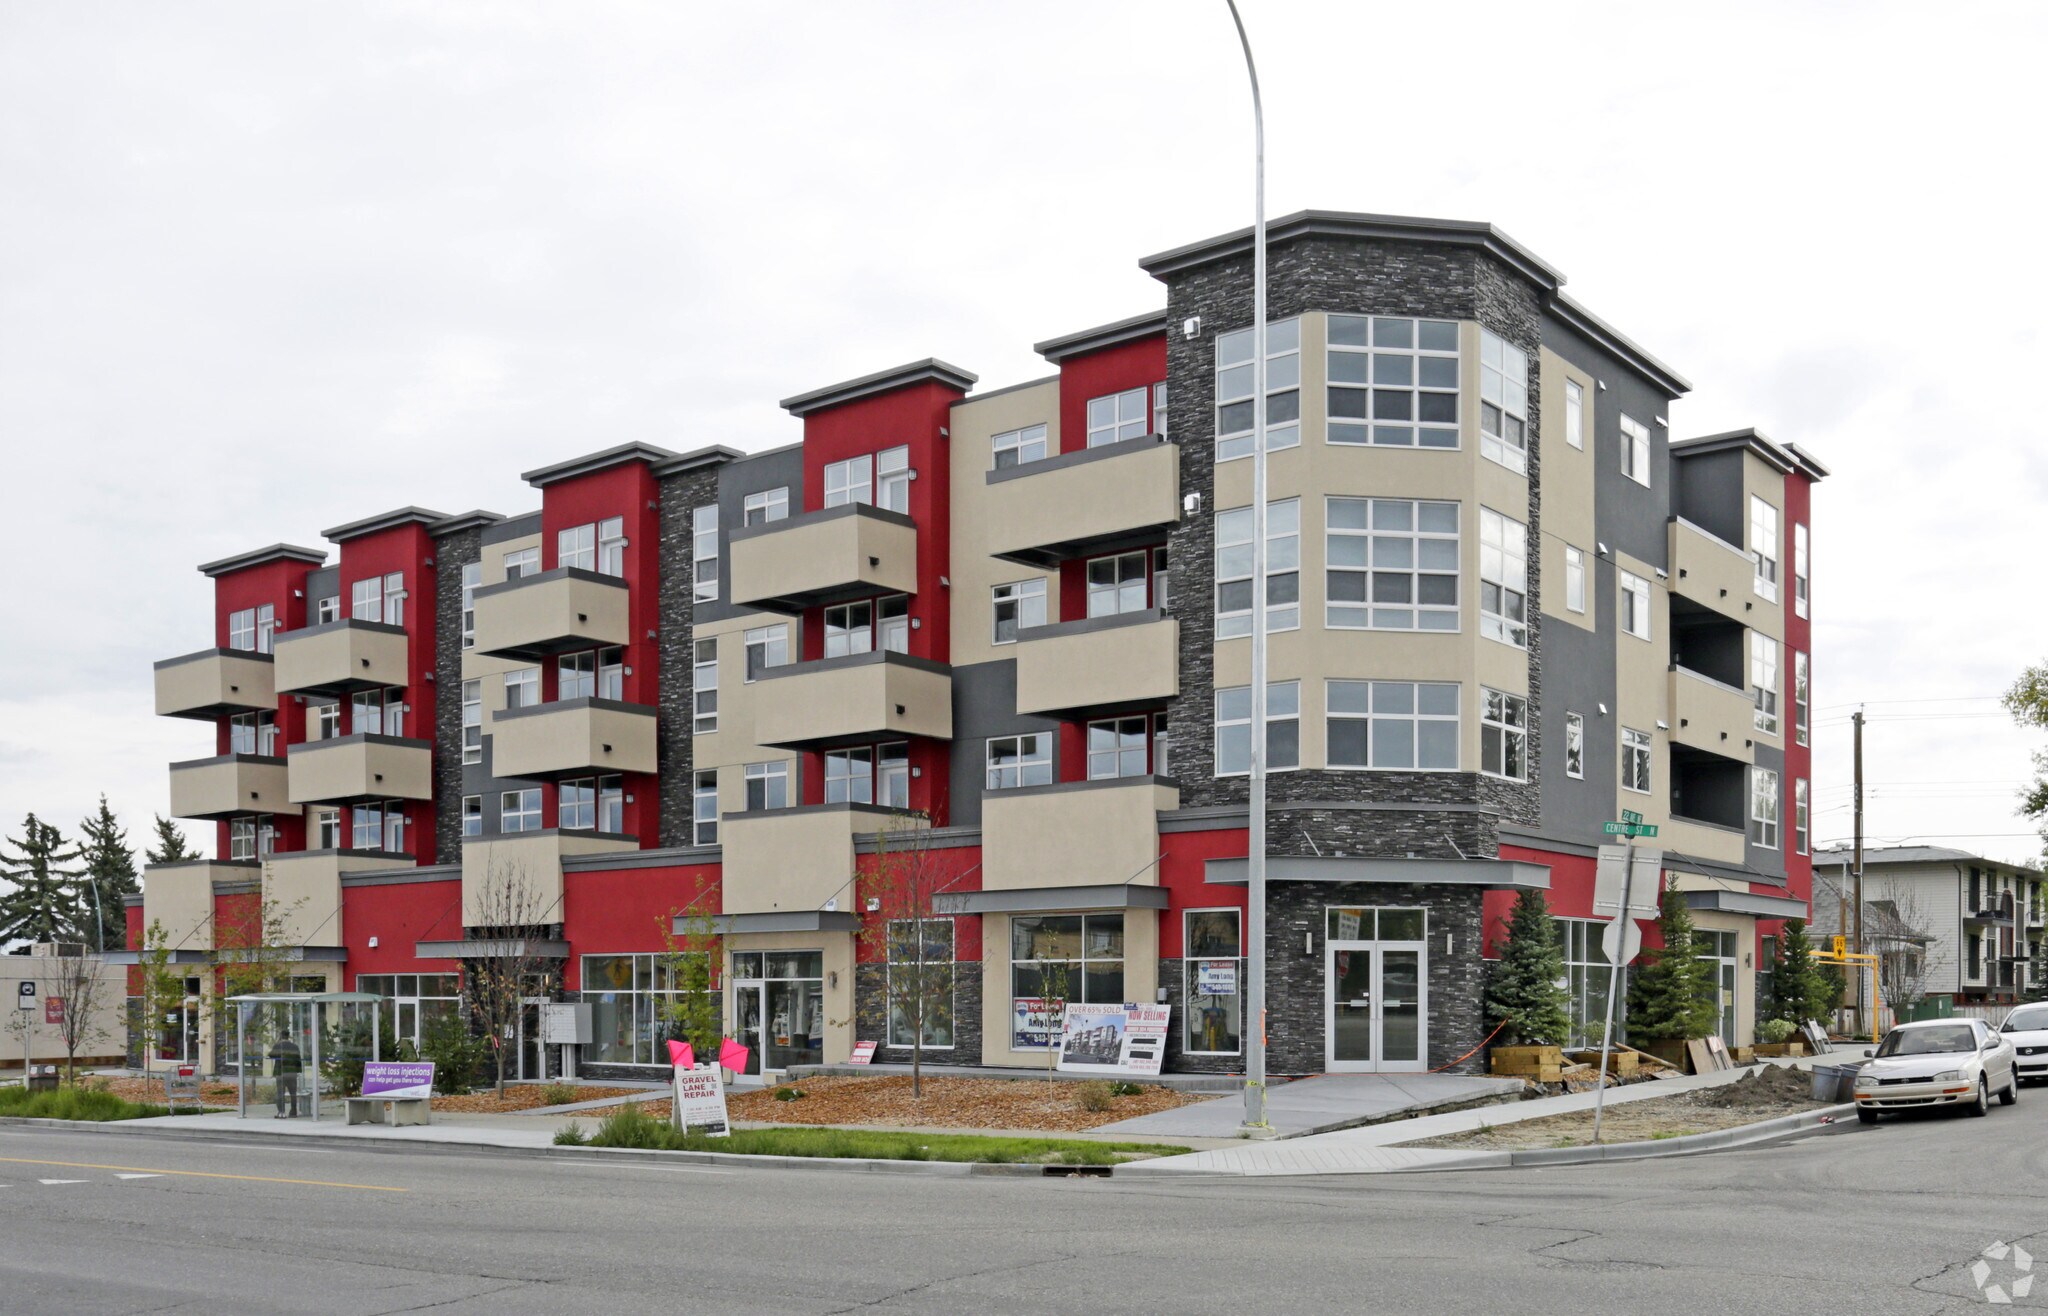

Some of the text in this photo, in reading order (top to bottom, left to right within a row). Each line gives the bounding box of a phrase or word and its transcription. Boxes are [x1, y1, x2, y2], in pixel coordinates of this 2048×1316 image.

[1623, 810, 1630, 820] 22
[1606, 823, 1655, 835] CENTRE ST N
[1029, 1002, 1041, 1011] For
[1068, 1006, 1086, 1014] OVER
[1102, 1006, 1121, 1014] SOLD
[1128, 1010, 1167, 1021] NOW SELLING
[367, 1066, 431, 1077] weight loss injections
[376, 1076, 386, 1084] help
[393, 1077, 401, 1085] you
[682, 1076, 716, 1084] GRAVEL
[684, 1090, 715, 1098] REPAIR
